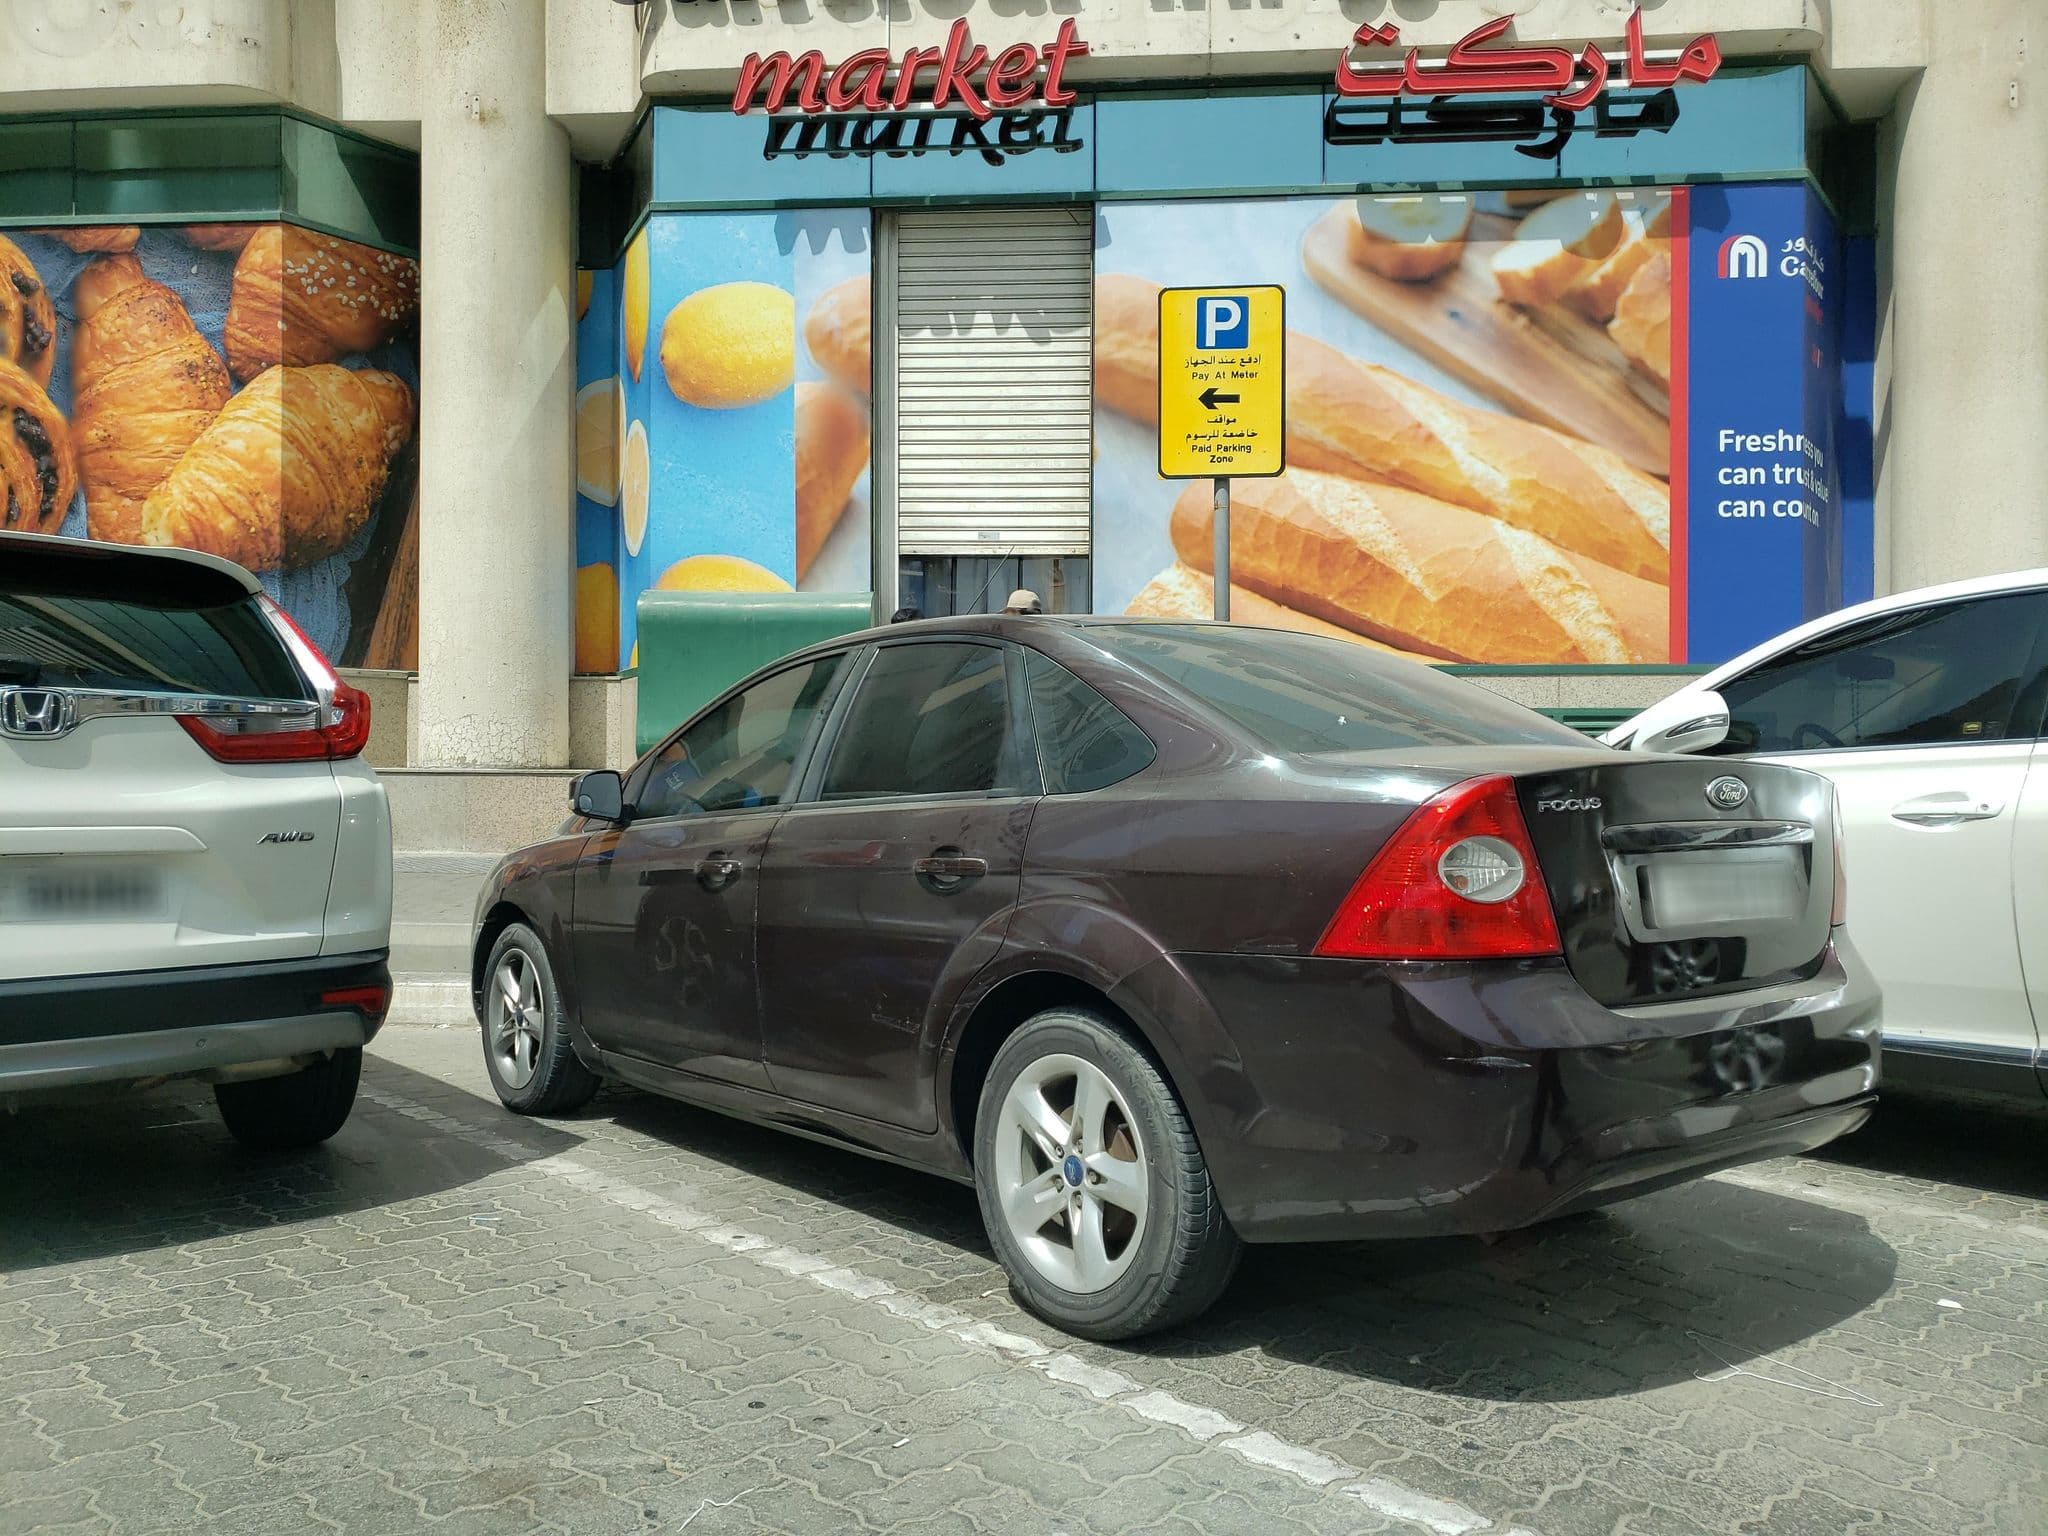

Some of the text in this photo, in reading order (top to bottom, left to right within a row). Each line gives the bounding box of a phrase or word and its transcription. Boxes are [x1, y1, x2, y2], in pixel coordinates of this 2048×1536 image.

[1335, 5, 1722, 111] ماركت
[732, 17, 1089, 120] market
[1206, 299, 1242, 347] P
[1191, 370, 1259, 381] Pay At Meter
[1207, 414, 1237, 425] مواقف
[1191, 443, 1252, 454] Paid Parking
[1209, 454, 1234, 464] Zone
[1718, 467, 1766, 485] can
[1718, 500, 1766, 518] can
[1720, 783, 1742, 801] Ford
[1537, 796, 1602, 813] FOCUS
[256, 830, 315, 845] AWD
